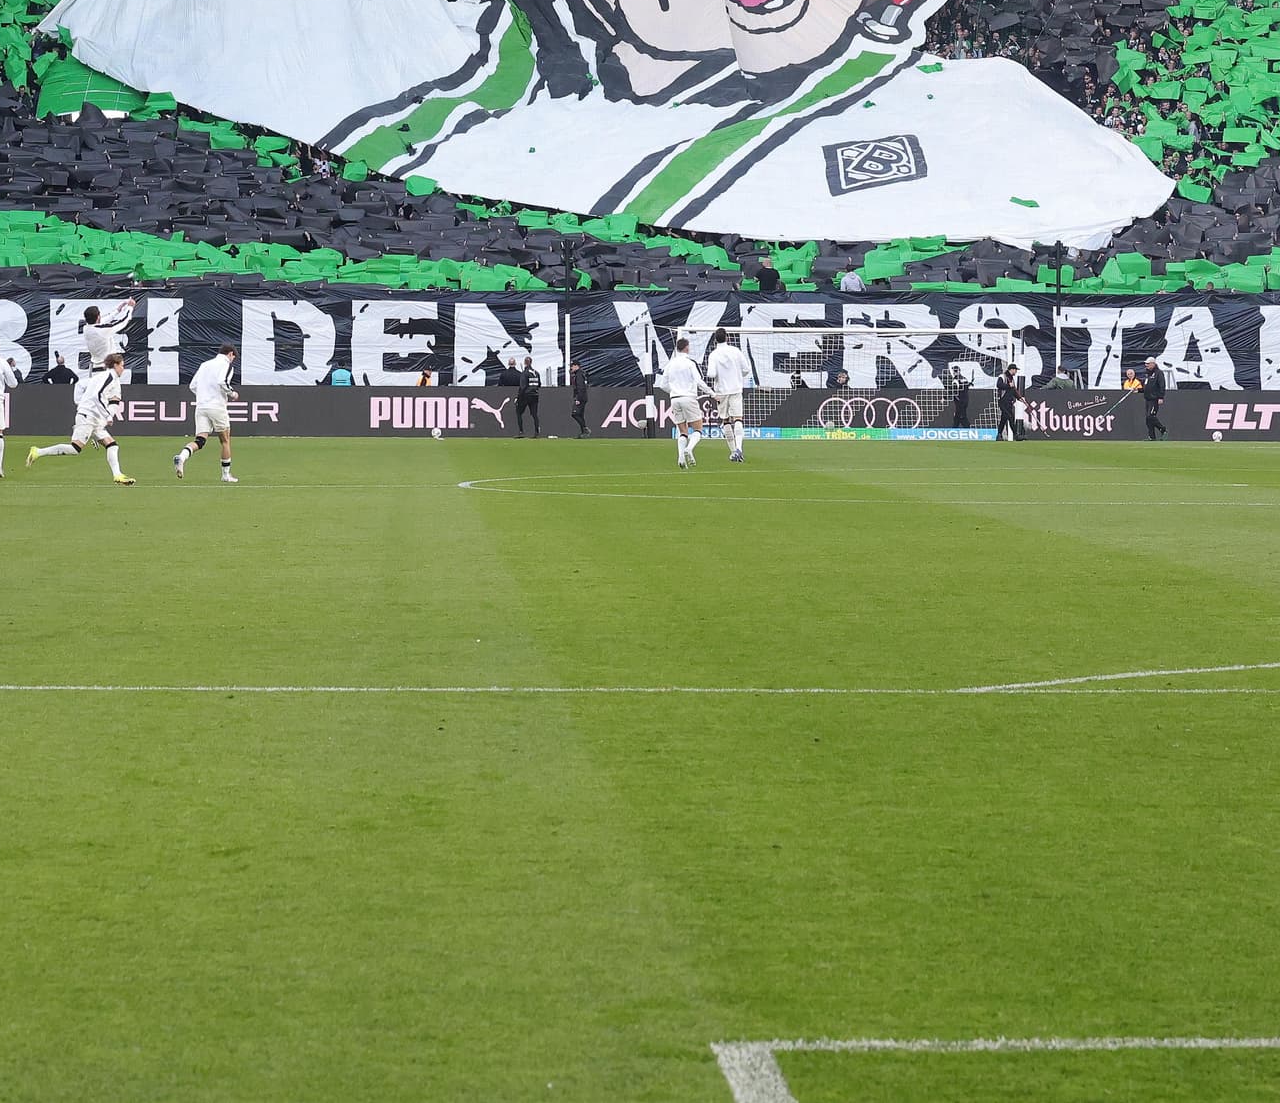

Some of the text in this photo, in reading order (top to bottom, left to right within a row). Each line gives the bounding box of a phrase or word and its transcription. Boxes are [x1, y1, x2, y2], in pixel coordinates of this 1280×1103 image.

[241, 298, 560, 387] DEN
[113, 401, 279, 423] REUER
[370, 397, 469, 429] PUMA
[601, 399, 675, 428] AOK
[1024, 400, 1116, 436] itburger
[920, 430, 979, 440] JONGEN
